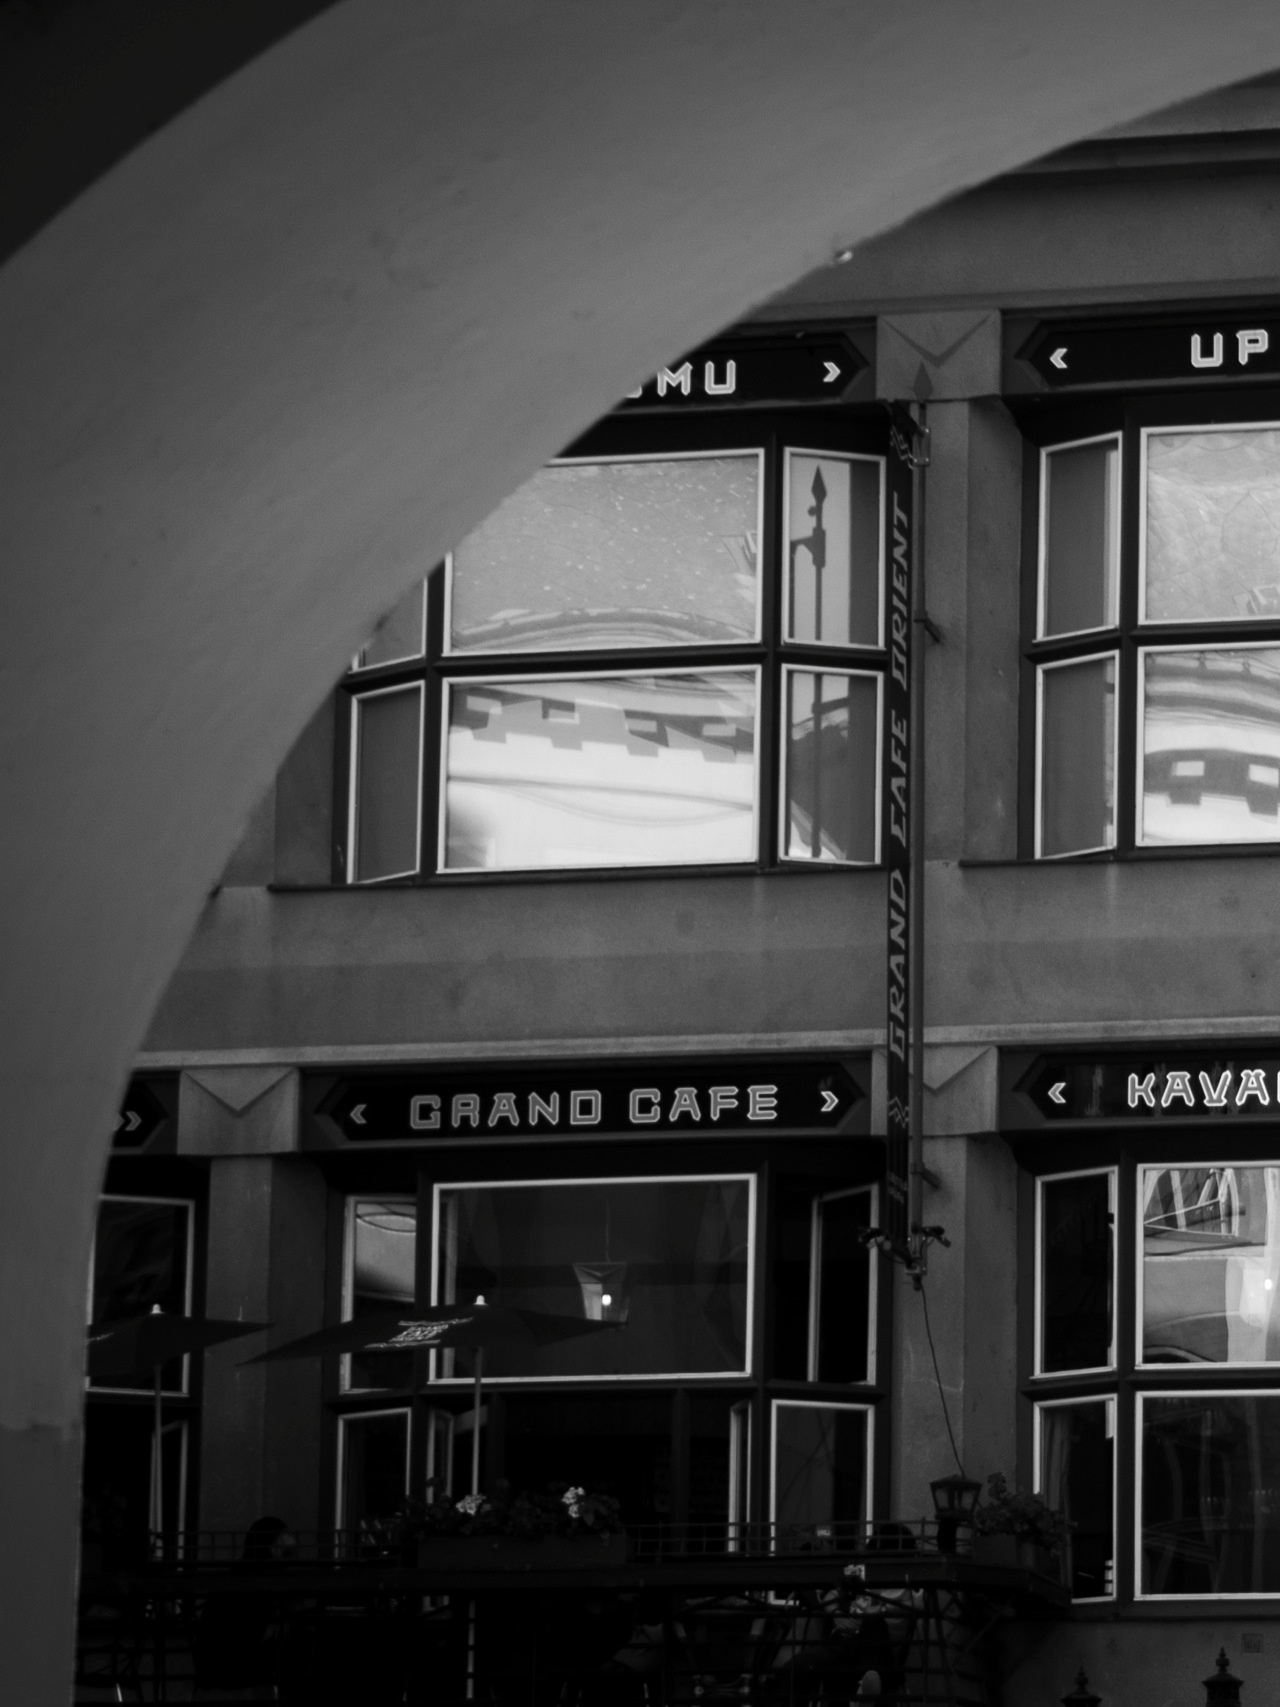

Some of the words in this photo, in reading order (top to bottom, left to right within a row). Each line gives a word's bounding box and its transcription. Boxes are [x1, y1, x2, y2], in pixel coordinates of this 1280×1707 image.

[626, 359, 737, 398] MU
[891, 490, 909, 692] ORIENT
[890, 708, 908, 849] CAFE
[890, 868, 907, 1062] GRAND
[409, 1089, 602, 1130] GRAND
[627, 1084, 779, 1124] CAFE
